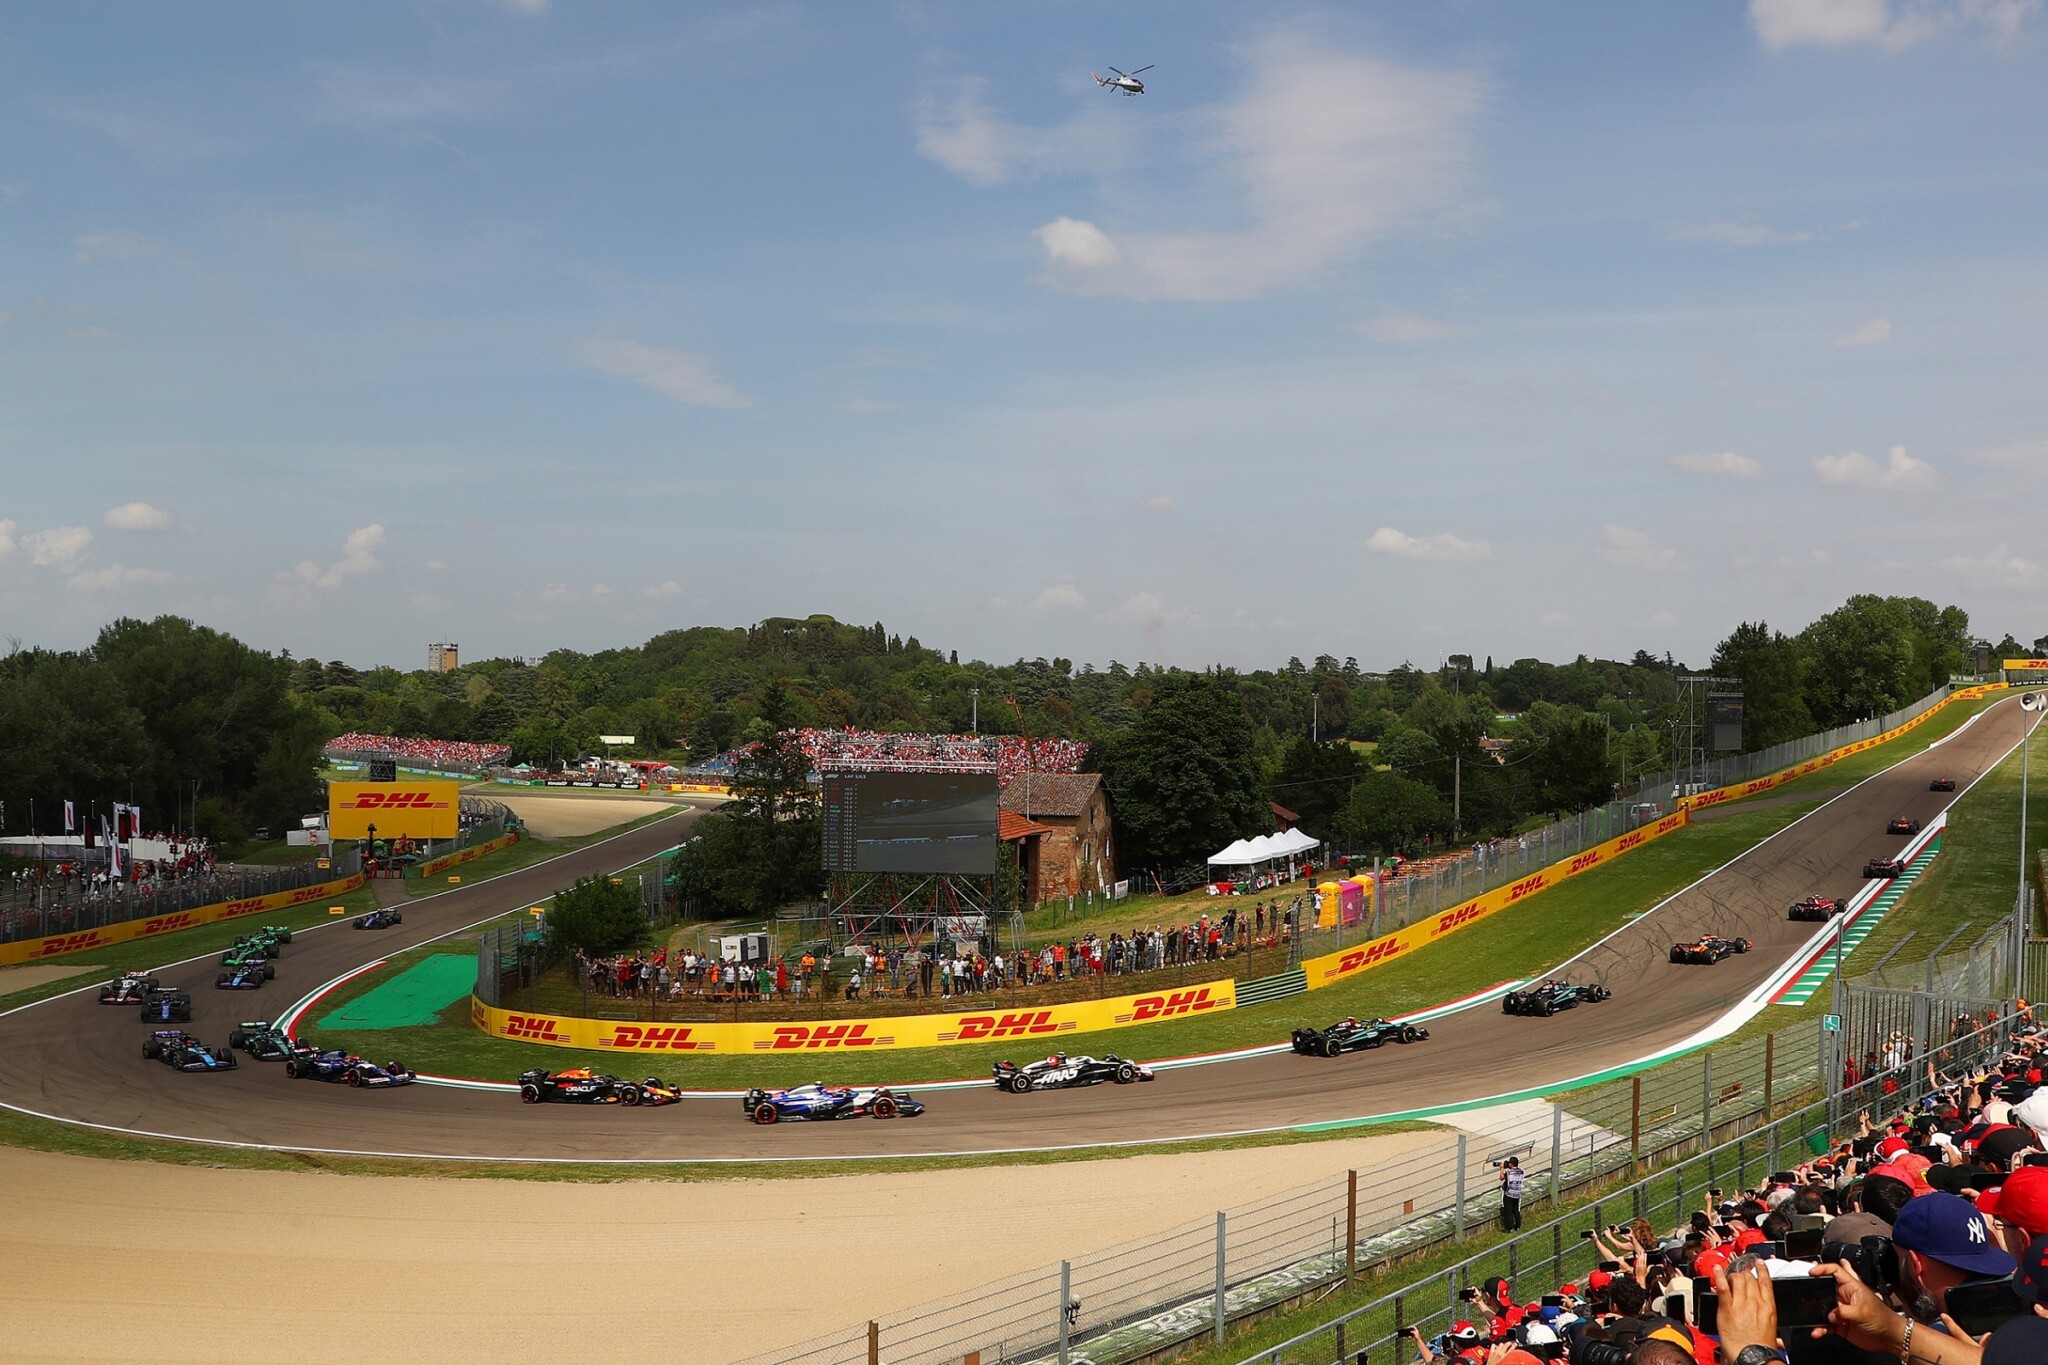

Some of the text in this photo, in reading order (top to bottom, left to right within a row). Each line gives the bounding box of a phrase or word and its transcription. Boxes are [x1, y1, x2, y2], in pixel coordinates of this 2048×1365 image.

[1747, 778, 1773, 793] DHL
[1782, 769, 1797, 781] DHL
[354, 792, 435, 808] DHL
[1696, 791, 1727, 806] DHL
[1658, 816, 1680, 833] DHL
[1618, 832, 1642, 851] DHL
[1571, 851, 1599, 872] DHL
[292, 886, 325, 903] DHL
[1510, 875, 1545, 900] DHL
[226, 899, 265, 916] DHL
[1438, 903, 1480, 933] DHL
[144, 913, 192, 935] DHL
[42, 931, 102, 956] DHL
[1338, 938, 1400, 973] DHL
[1132, 988, 1216, 1020] DHL
[506, 1015, 560, 1042] DHL
[957, 1011, 1058, 1039] DHL
[612, 1026, 698, 1049] DHL
[772, 1024, 875, 1049] DHL
[1040, 1068, 1079, 1084] HAAS
